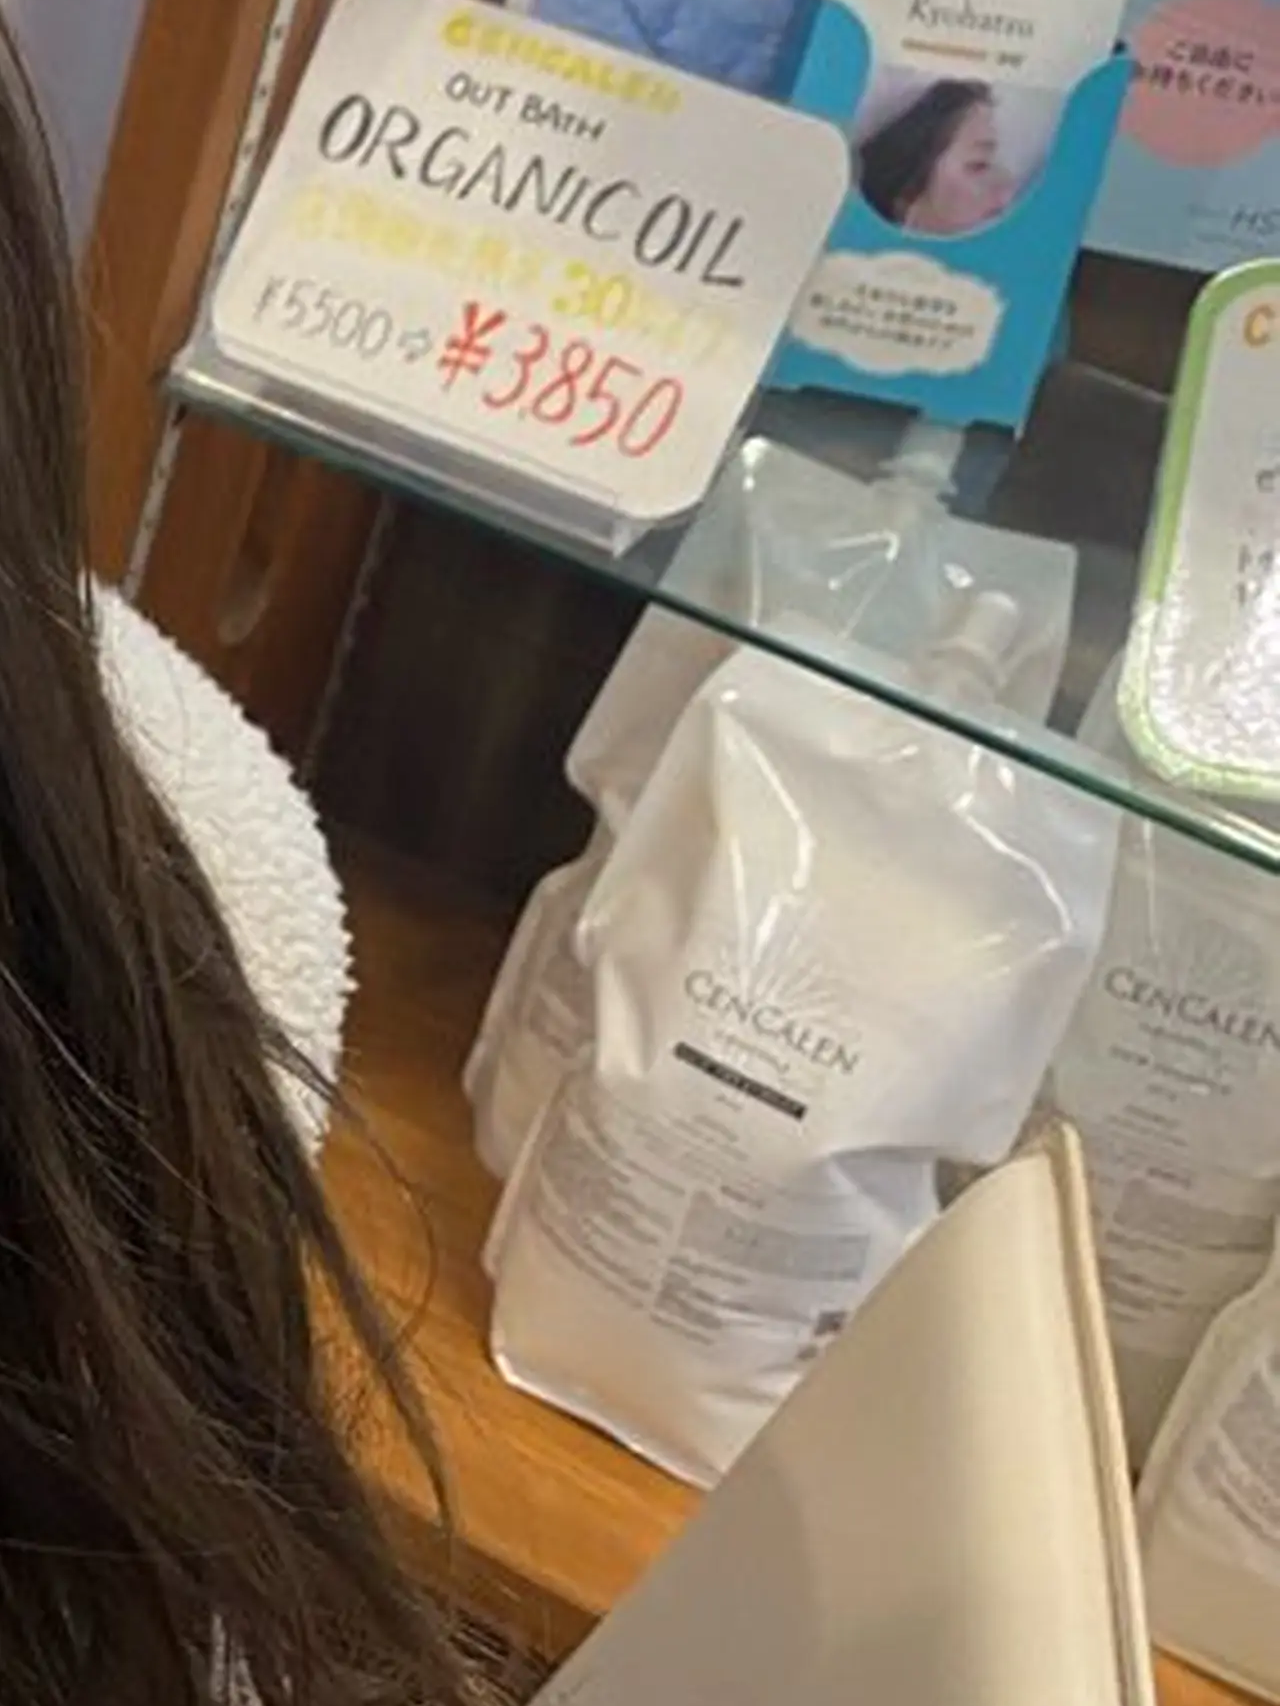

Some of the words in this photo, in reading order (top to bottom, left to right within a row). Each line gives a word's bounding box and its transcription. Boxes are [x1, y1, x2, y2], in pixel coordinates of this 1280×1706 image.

[445, 72, 511, 113] OUT
[318, 93, 643, 242] ORGANIC
[633, 193, 746, 289] OIL
[438, 301, 683, 459] ¥3850
